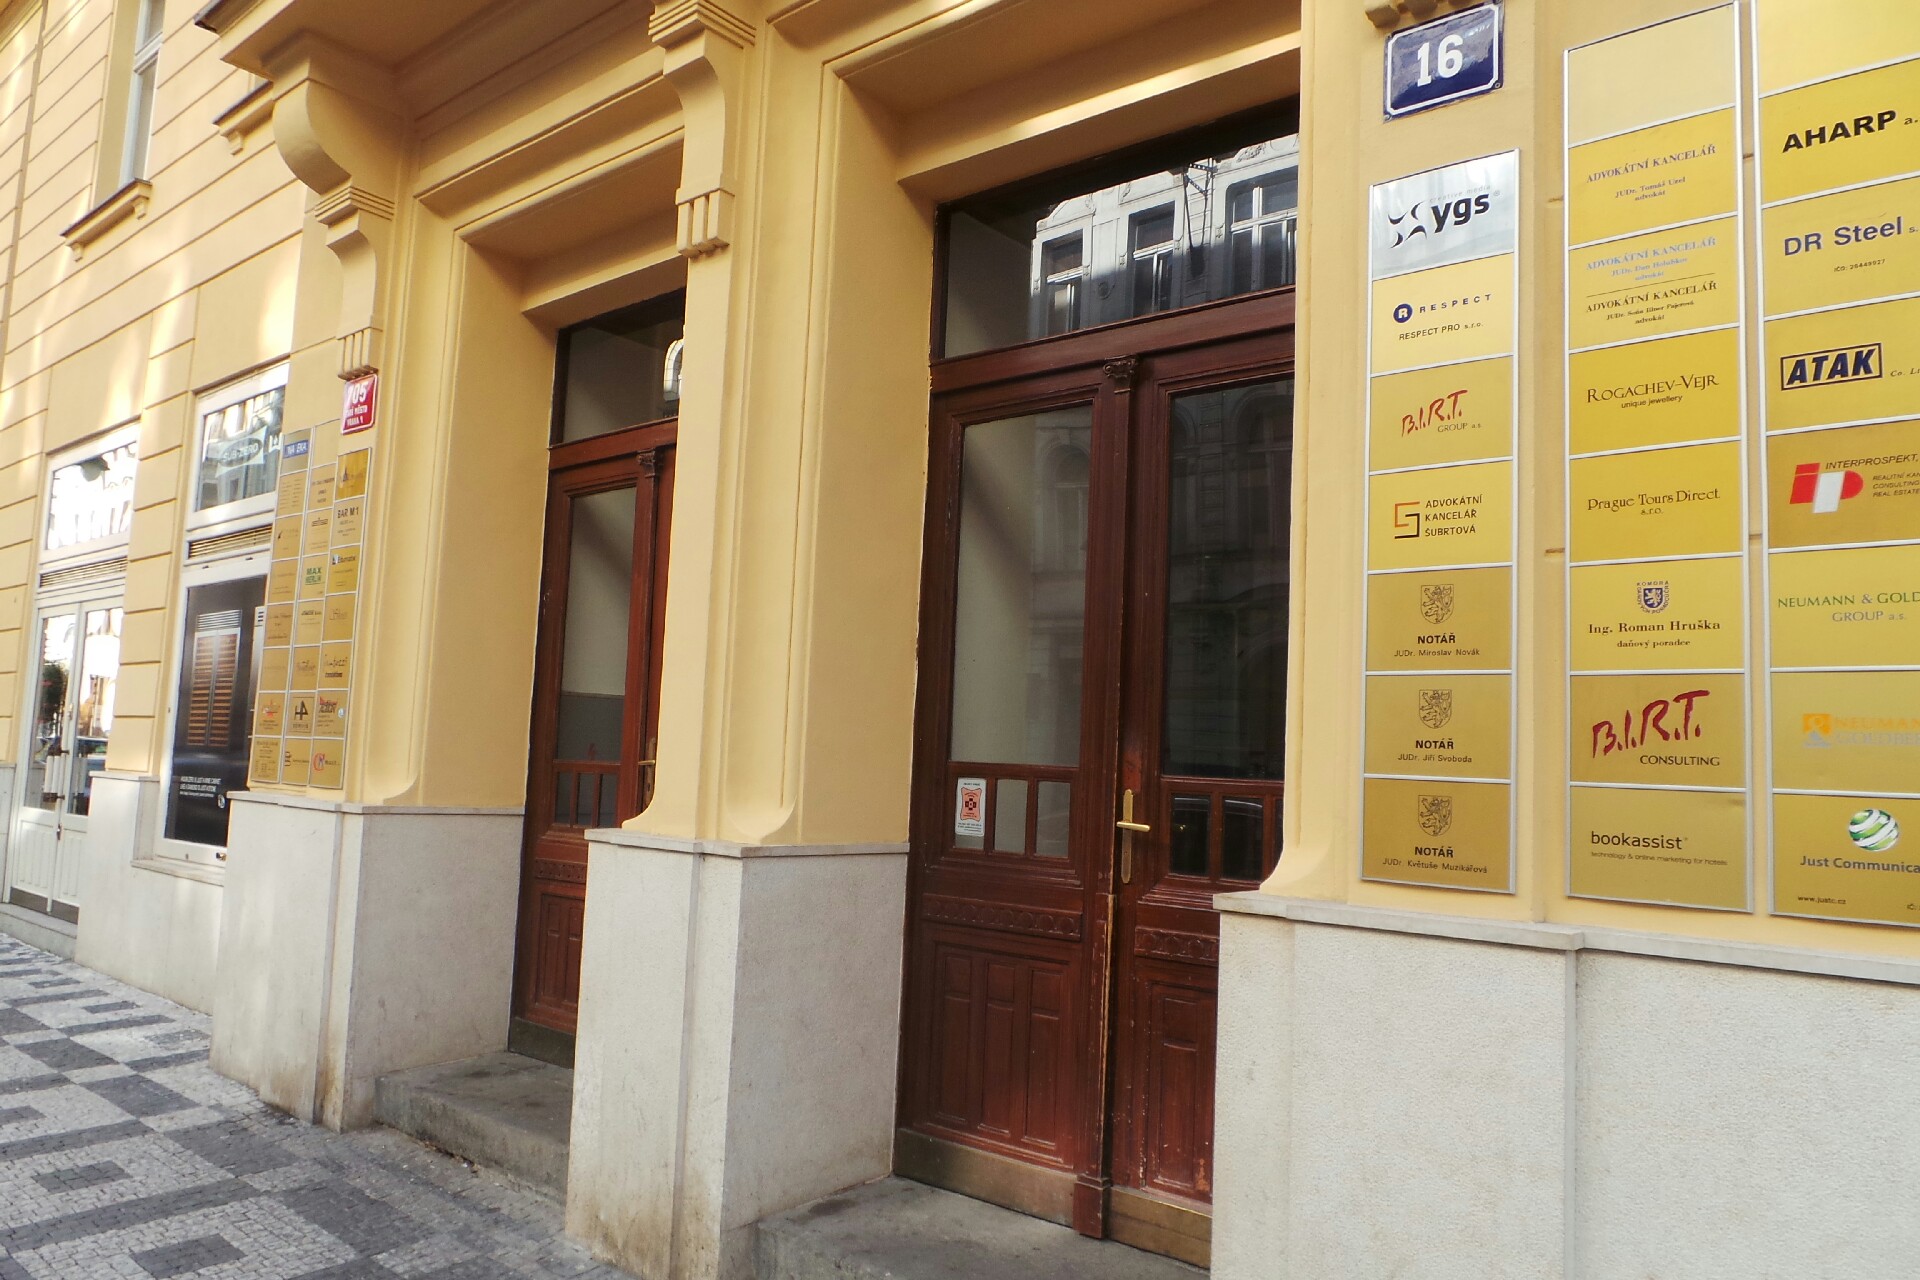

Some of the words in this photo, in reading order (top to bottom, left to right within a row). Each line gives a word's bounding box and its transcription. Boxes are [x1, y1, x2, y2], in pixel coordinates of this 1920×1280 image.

[1417, 34, 1464, 87] 16
[1782, 109, 1897, 153] AHARP
[1586, 158, 1649, 183] ADVOKÁTNÍ
[1652, 143, 1717, 168] KANCELÁŘ
[1430, 193, 1490, 234] ygs
[1784, 232, 1823, 256] DR
[1833, 215, 1904, 246] Steel
[1419, 293, 1492, 314] RESPECT
[1586, 292, 1649, 313] ADVOKÁTNÍ
[1653, 280, 1718, 300] KANCELÁŘ
[1398, 327, 1439, 341] RESPECT
[1441, 323, 1461, 334] PRO
[1786, 348, 1876, 386] ATAK
[1621, 398, 1647, 409] unique
[1647, 394, 1683, 407] jewellery
[1401, 389, 1468, 438] B.I.R.T.
[1437, 422, 1468, 433] GROUP
[1425, 494, 1483, 509] ADVOKÁTNÍ
[1587, 497, 1635, 512] Prague
[1638, 493, 1674, 505] Tours
[1676, 487, 1720, 503] Direct
[1425, 508, 1478, 522] KANCELÁŘ
[1425, 524, 1476, 537] ŠUBRTOVÁ
[1778, 595, 1856, 608] NEUMANN
[1861, 594, 1873, 604] &
[1832, 610, 1884, 622] GROUP
[1589, 623, 1613, 636] Ing.
[1618, 622, 1665, 633] Roman
[1670, 619, 1721, 631] Hruška
[1417, 632, 1456, 645] NOTÁŘ
[1617, 639, 1650, 648] daňový
[1652, 638, 1691, 648] poradce
[1394, 649, 1416, 657] JUDr.
[1418, 649, 1452, 657] Miroslav
[1455, 648, 1480, 656] Novák
[1592, 689, 1711, 759] B.I.R.T.
[1415, 738, 1454, 750] NOTÁŘ
[1397, 753, 1420, 761] JUDr.
[1438, 754, 1473, 763] Svoboda
[1639, 755, 1720, 766] CONSULTING
[1591, 830, 1683, 850] bookassist
[1414, 846, 1454, 858] NOTÁŘ
[1591, 851, 1626, 860] technology
[1634, 853, 1655, 861] online
[1656, 856, 1692, 865] marketing
[1407, 859, 1439, 870] Květuše
[1800, 855, 1829, 867] Just
